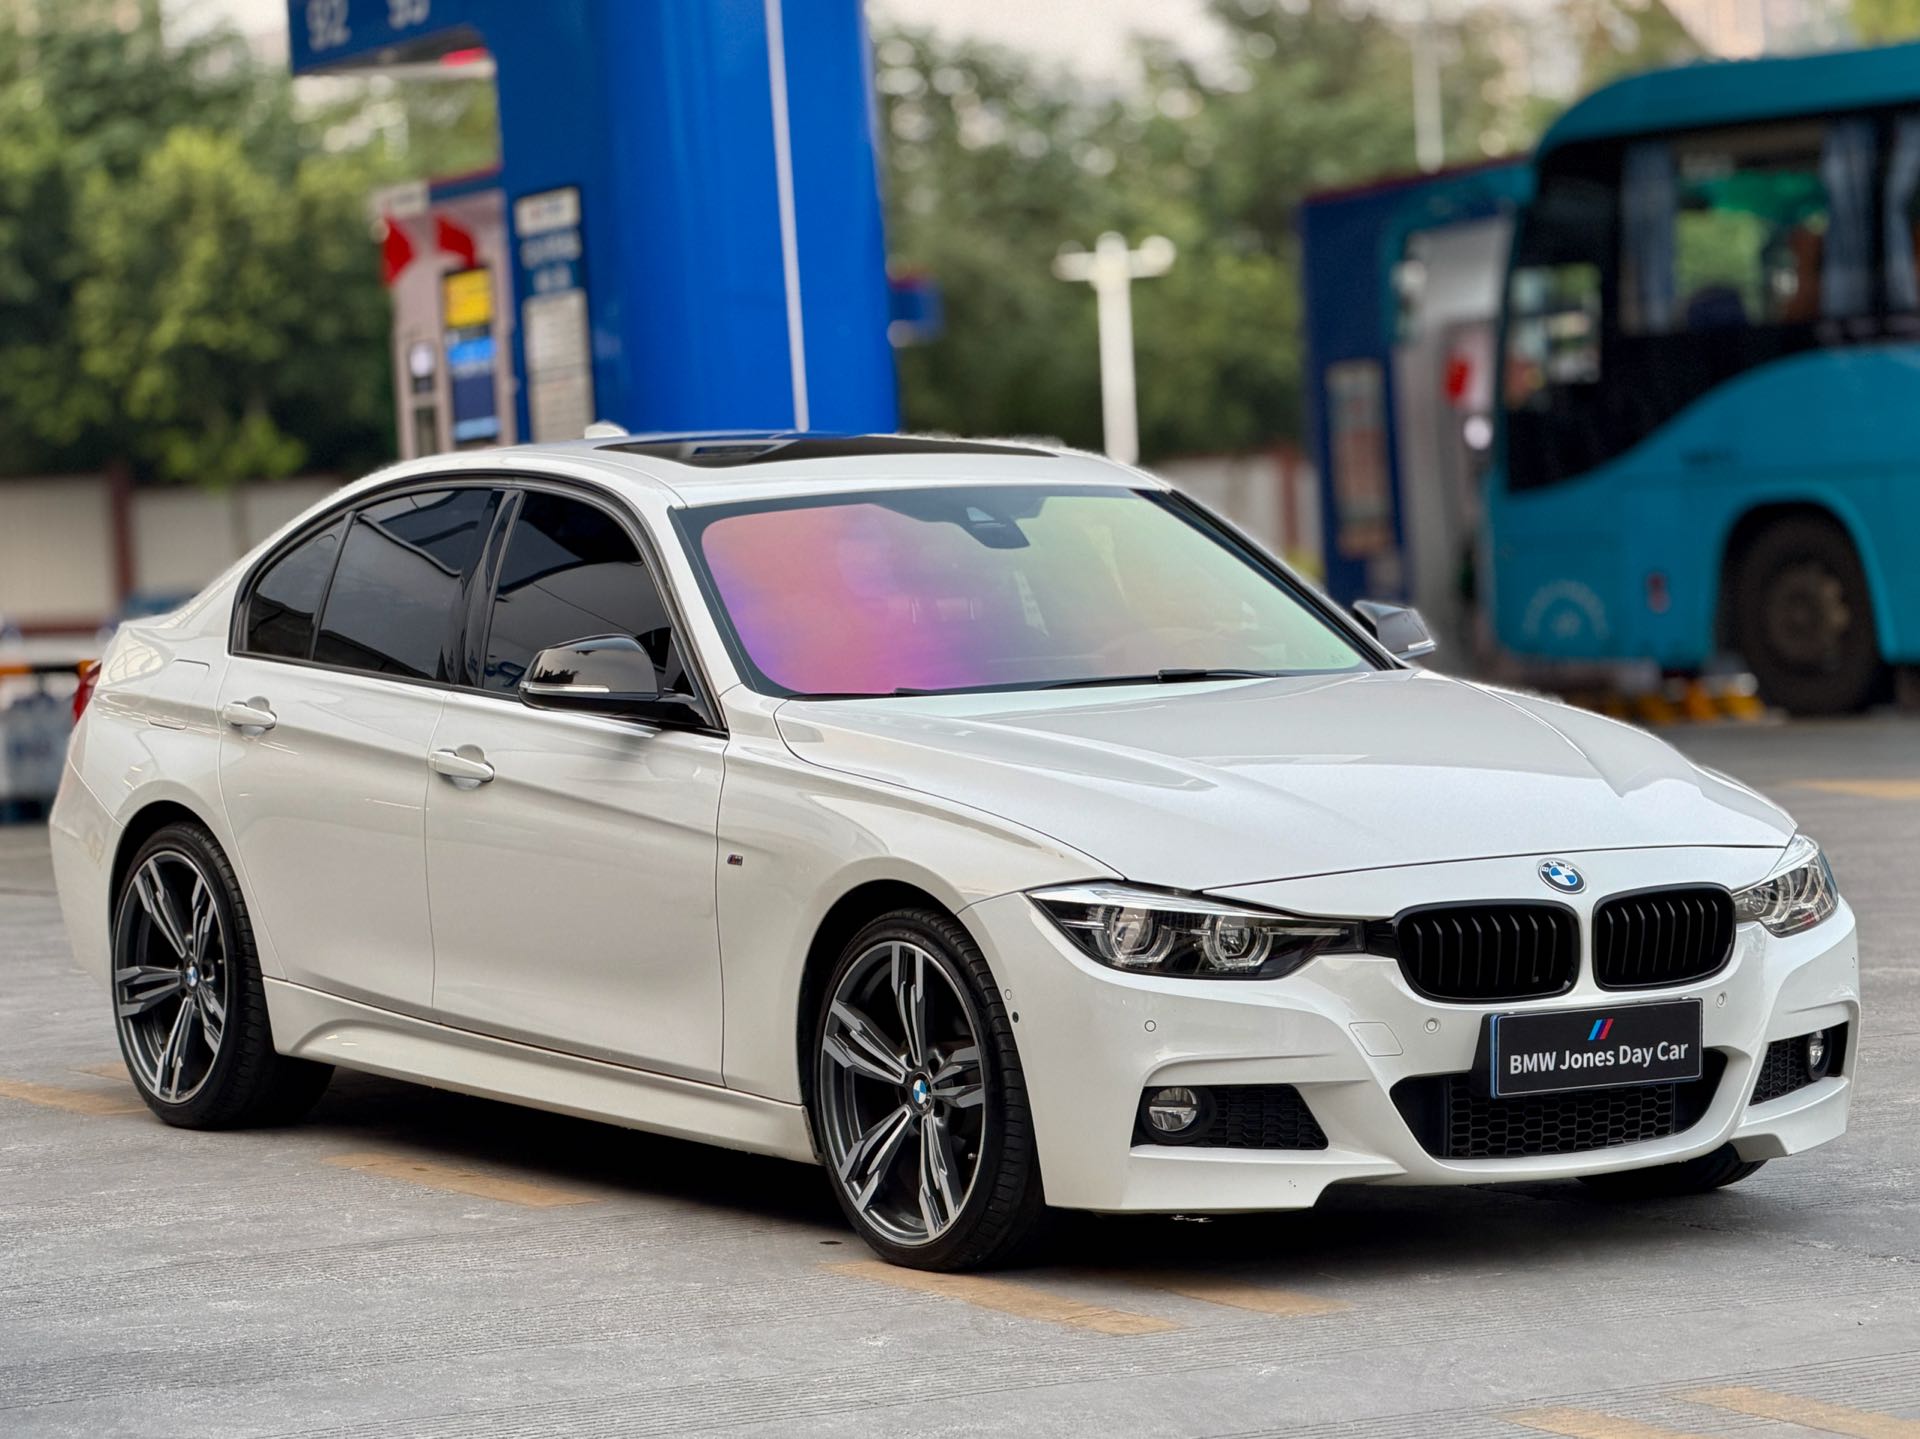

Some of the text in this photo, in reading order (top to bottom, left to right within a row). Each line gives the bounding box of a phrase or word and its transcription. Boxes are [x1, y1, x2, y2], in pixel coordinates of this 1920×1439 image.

[1509, 1041, 1689, 1075] BMW Jones Day Car
